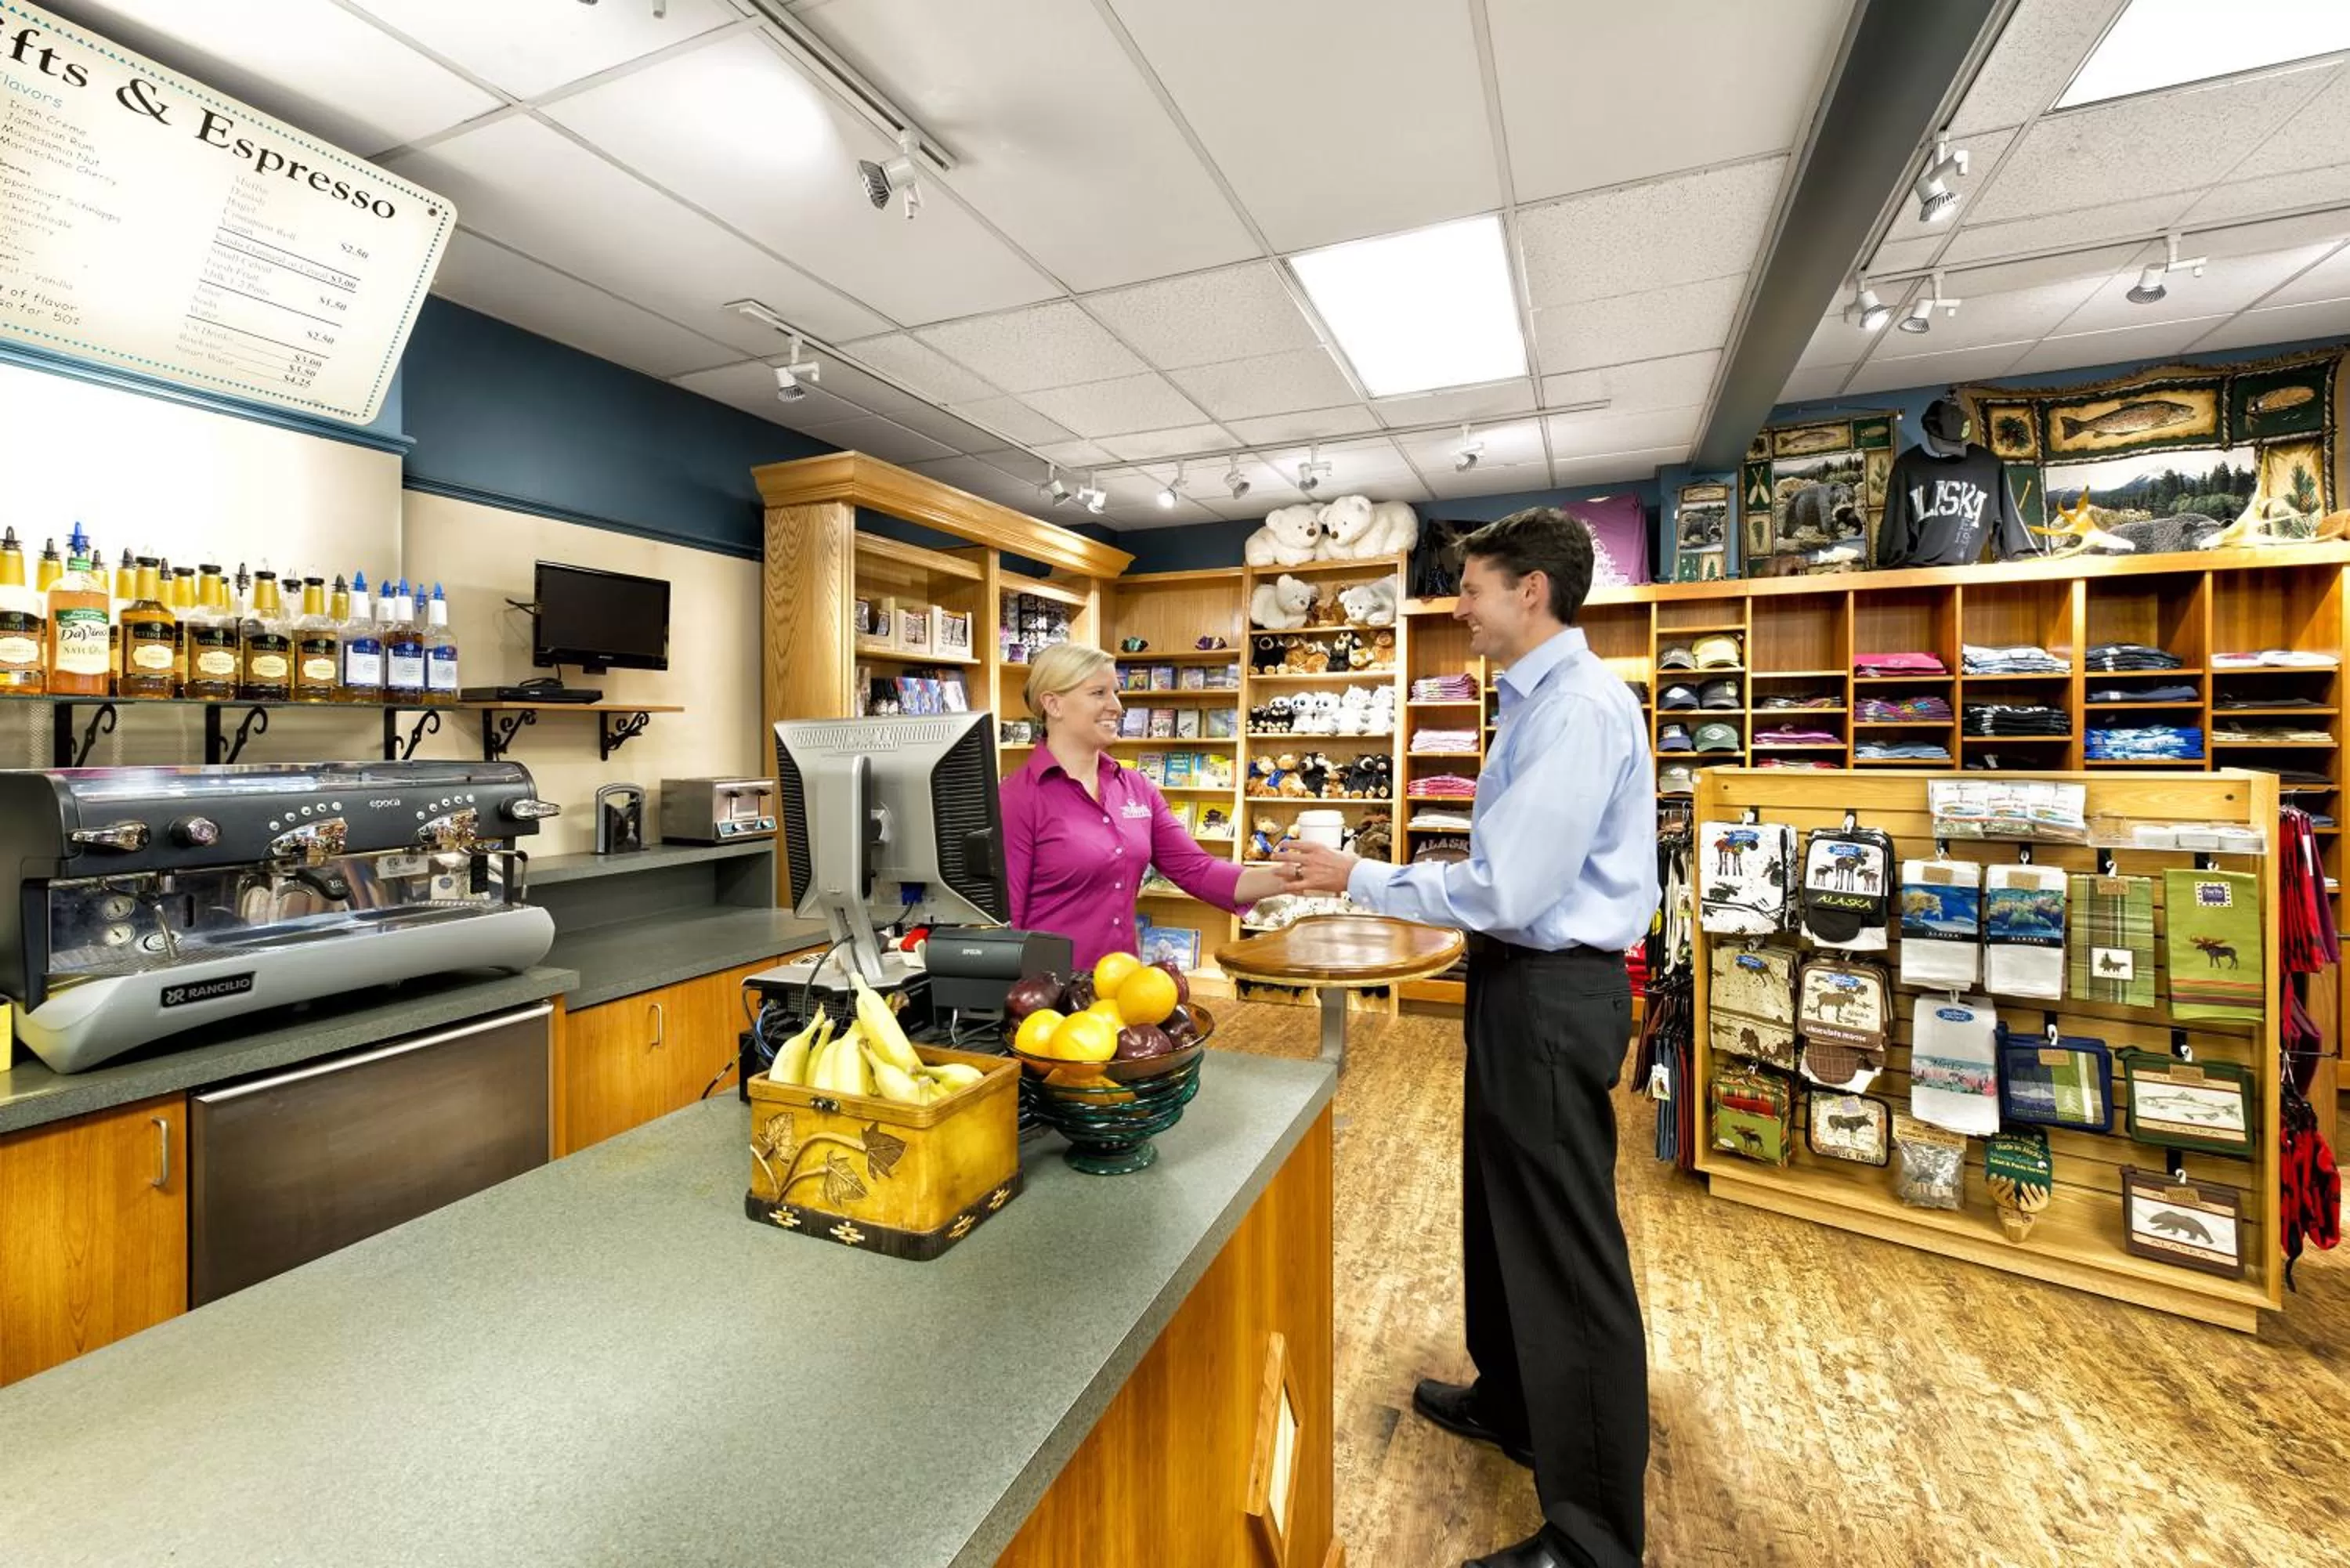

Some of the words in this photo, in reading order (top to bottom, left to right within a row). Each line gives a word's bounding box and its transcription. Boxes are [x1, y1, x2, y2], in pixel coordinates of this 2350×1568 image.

[0, 71, 63, 109] lavors
[9, 99, 42, 119] Irish
[0, 19, 89, 88] fts
[115, 78, 172, 126] &
[193, 107, 396, 220] Espresso
[1415, 837, 1470, 854] ALASK
[1817, 894, 1873, 909] ALASKA
[188, 978, 250, 999] RANCILIO
[2150, 1239, 2210, 1258] ALASKA
